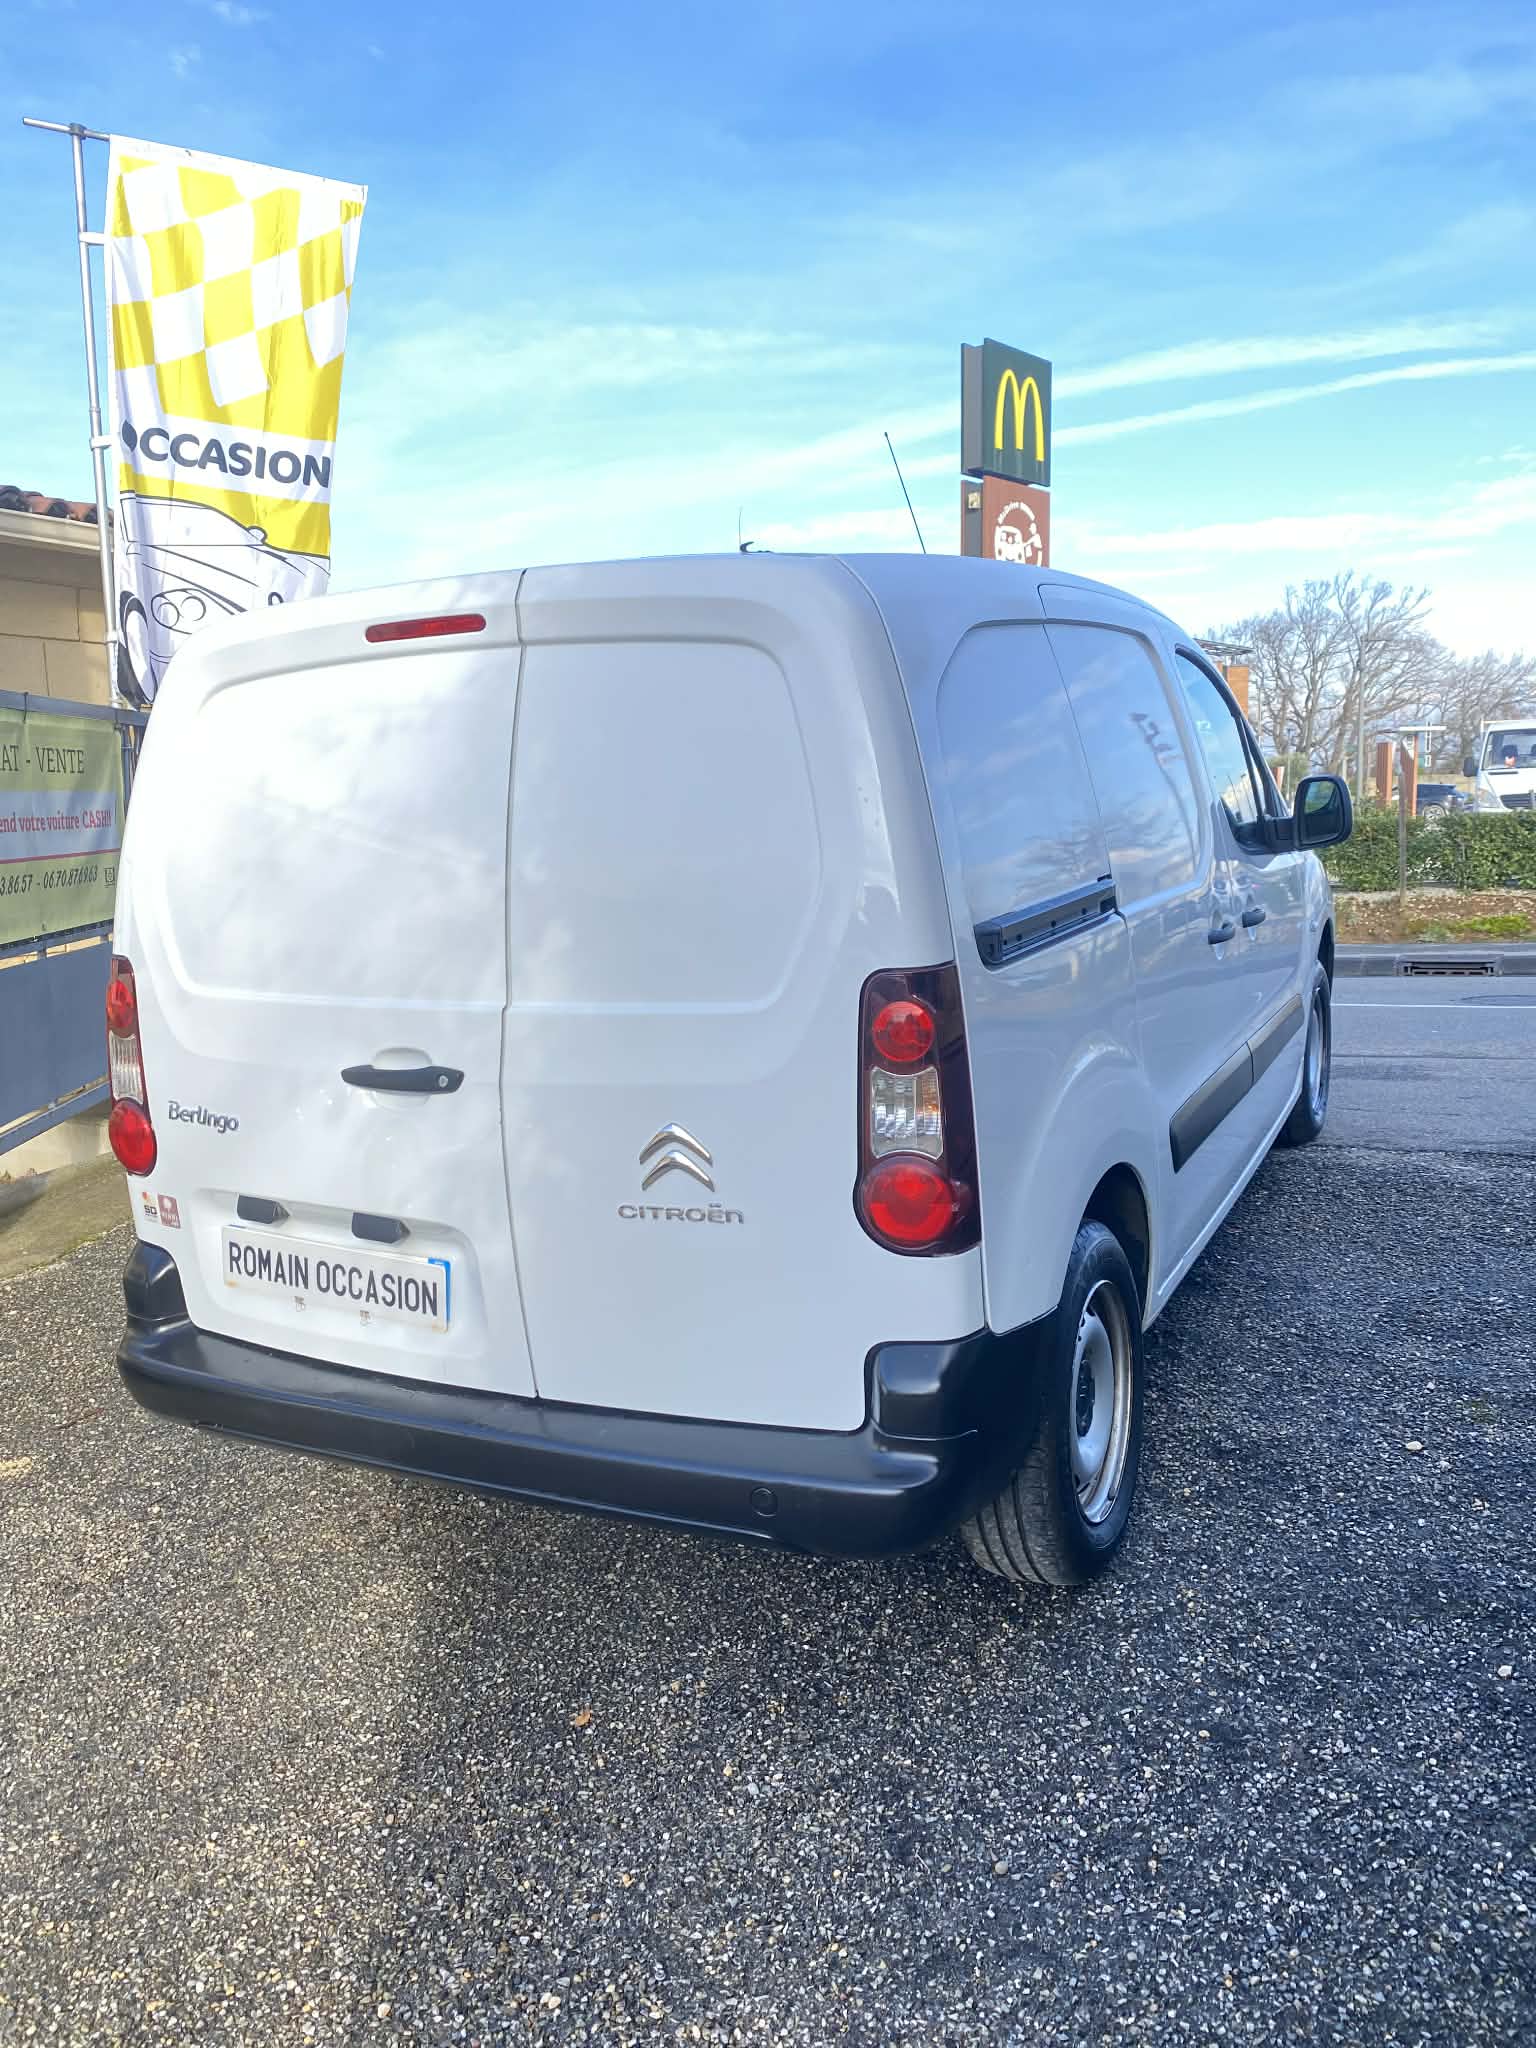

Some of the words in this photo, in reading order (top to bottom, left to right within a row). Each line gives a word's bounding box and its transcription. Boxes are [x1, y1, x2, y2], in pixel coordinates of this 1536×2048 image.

[36, 747, 85, 774] VENTE
[19, 815, 46, 832] votre
[47, 810, 80, 831] voiture
[168, 1100, 239, 1133] Berlingo
[228, 1241, 309, 1290] ROMAIN
[316, 1261, 438, 1317] OCCASION
